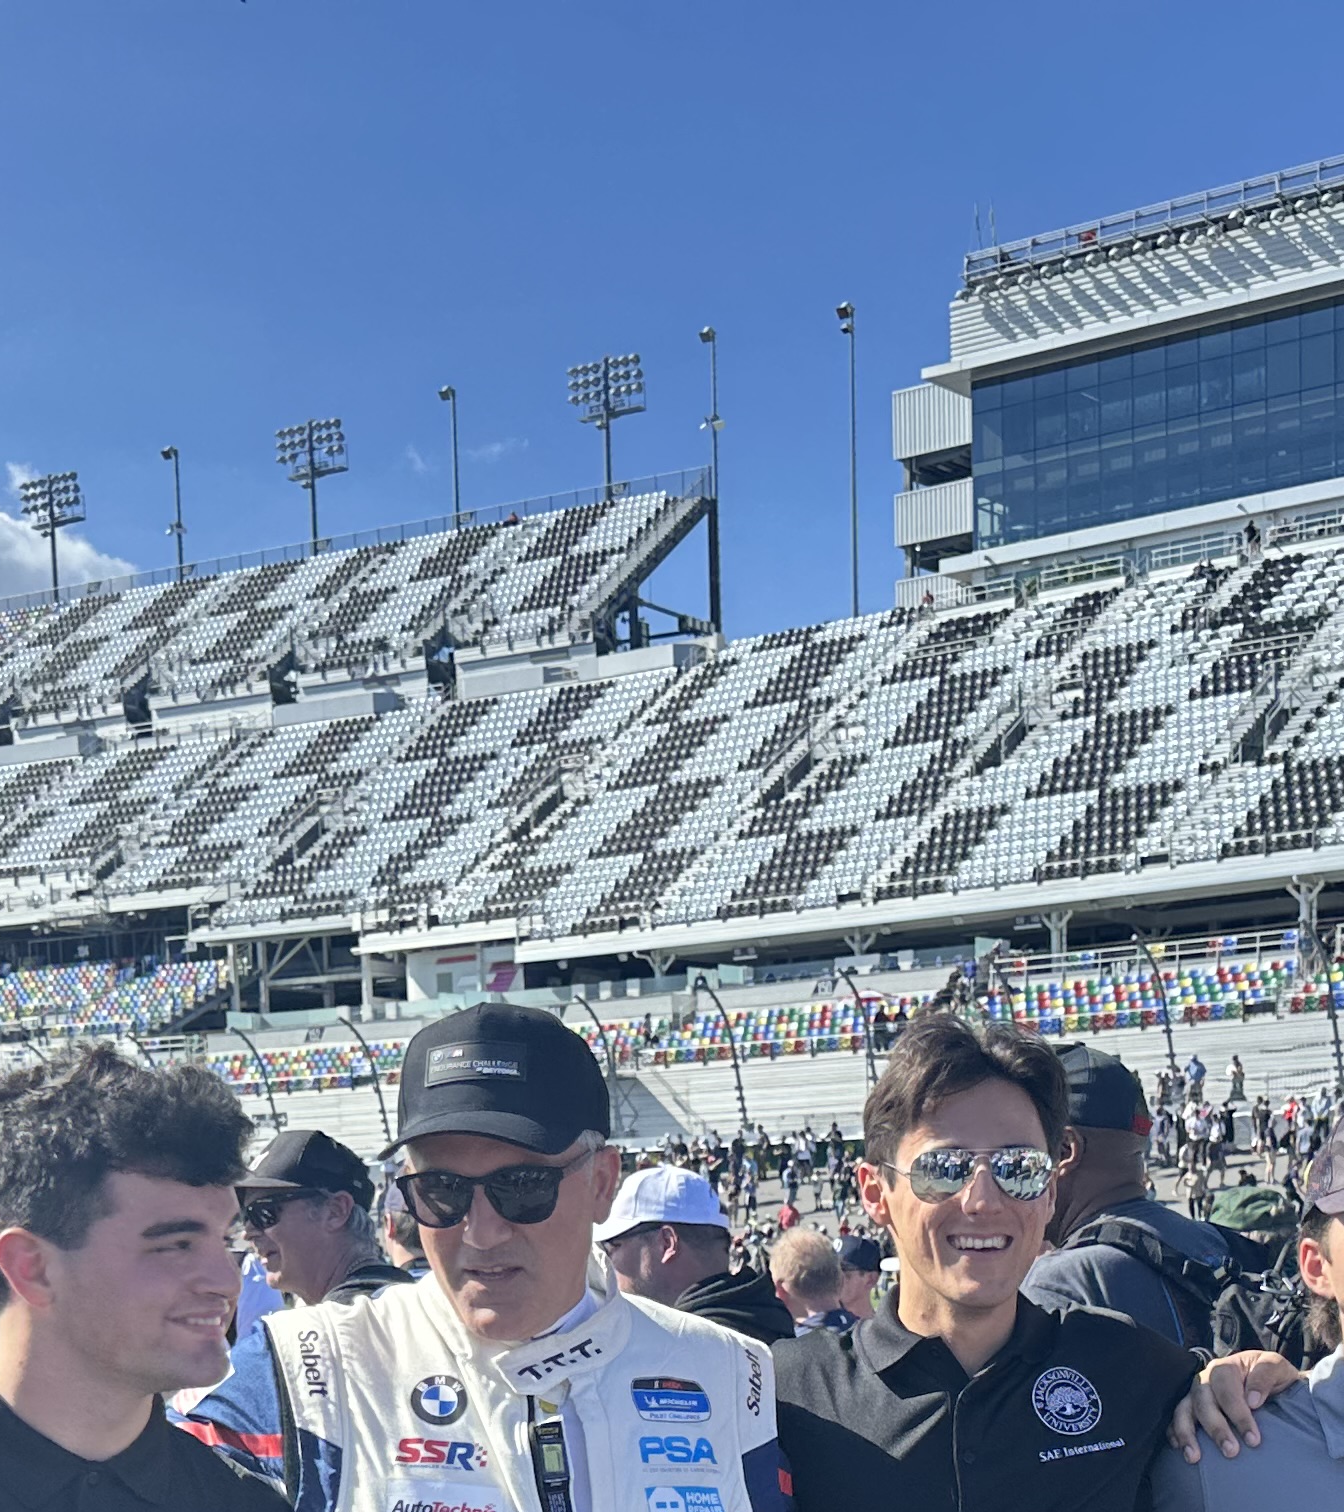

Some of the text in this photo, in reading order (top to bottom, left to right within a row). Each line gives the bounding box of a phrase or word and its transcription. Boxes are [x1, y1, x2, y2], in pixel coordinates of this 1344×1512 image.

[297, 1330, 329, 1398] Sabelt
[517, 1338, 603, 1381] T.T.T.
[416, 1375, 464, 1393] BMW
[744, 1348, 763, 1417] Sabelt
[1035, 1369, 1092, 1401] JACKSONVILLE
[1043, 1404, 1098, 1432] UNIVERSITY
[395, 1437, 475, 1472] SSR
[638, 1435, 718, 1465] PSA
[1039, 1437, 1126, 1463] SAE International
[686, 1491, 719, 1505] HOME
